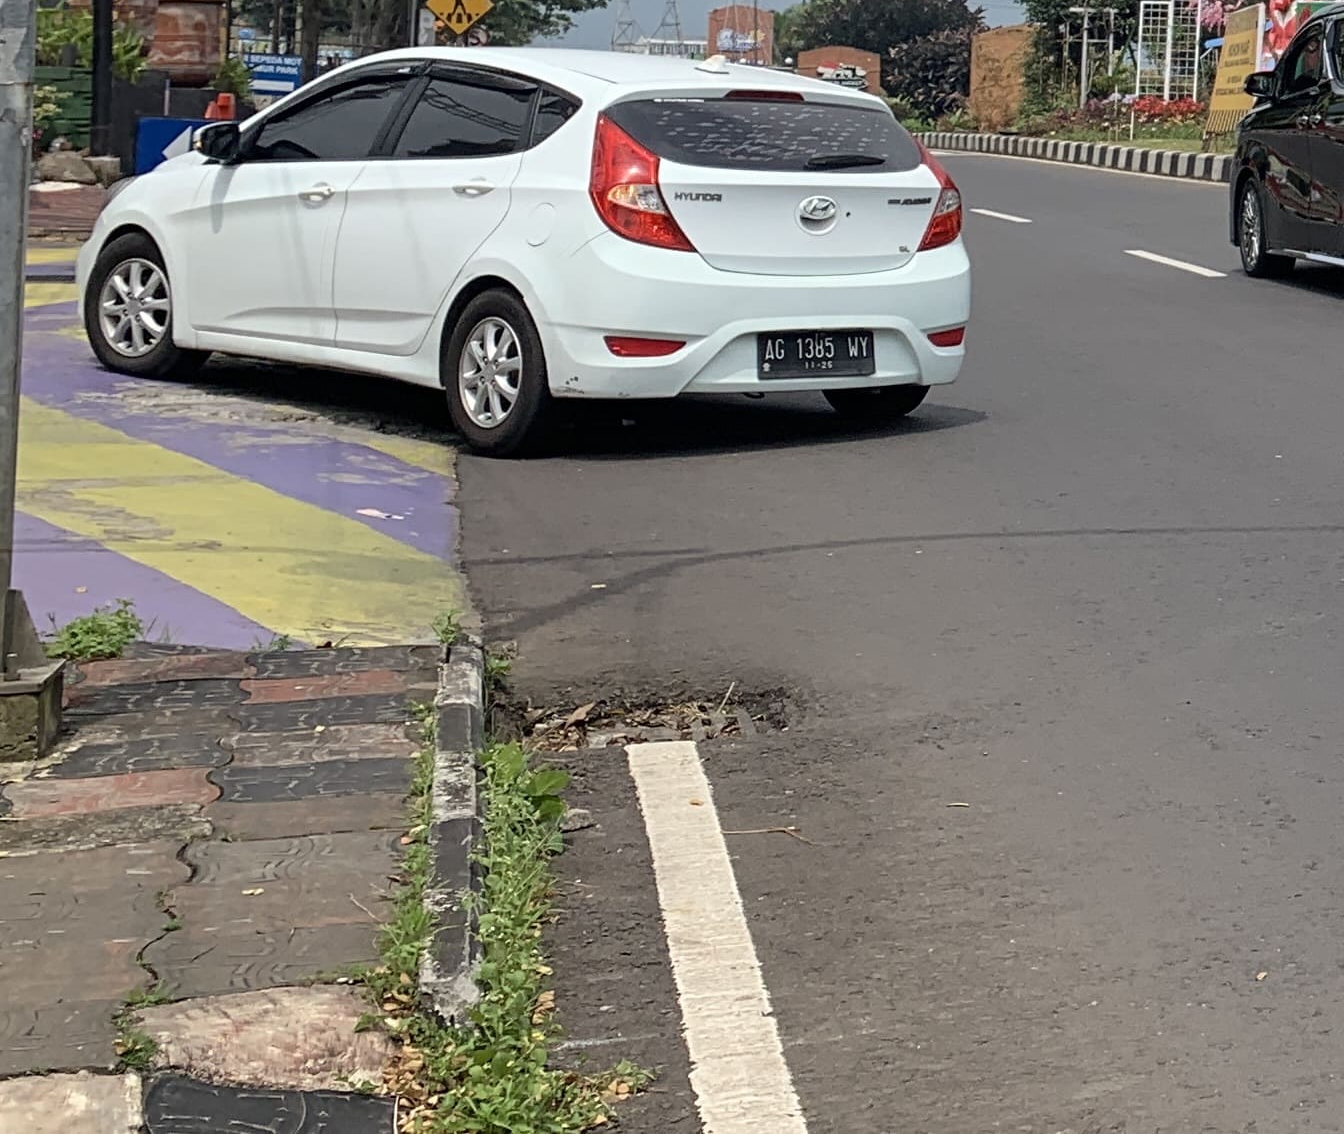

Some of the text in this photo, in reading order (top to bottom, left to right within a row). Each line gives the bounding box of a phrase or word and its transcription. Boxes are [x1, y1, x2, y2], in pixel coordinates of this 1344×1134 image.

[765, 336, 868, 360] AG 1385 WY
